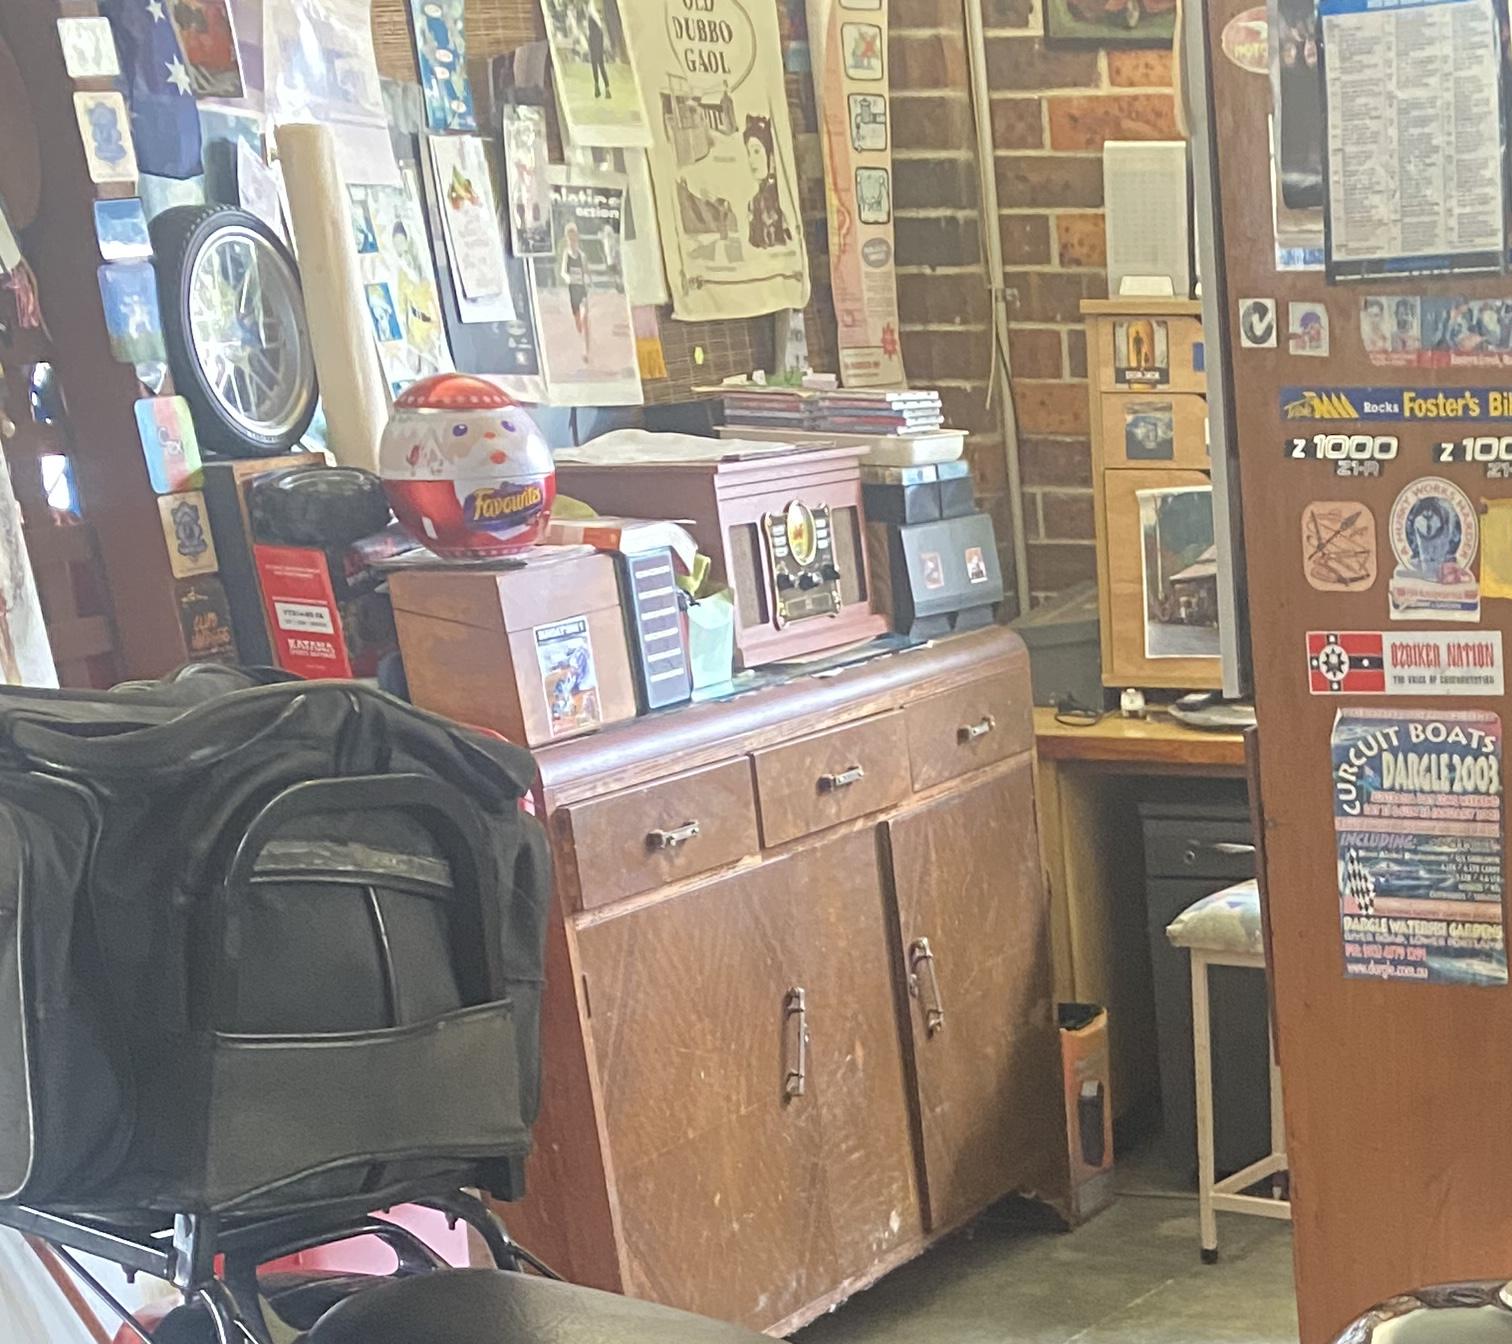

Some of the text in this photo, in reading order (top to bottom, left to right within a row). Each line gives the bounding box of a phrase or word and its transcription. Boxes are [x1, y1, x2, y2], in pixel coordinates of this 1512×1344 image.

[673, 16, 733, 44] DUBBO
[685, 49, 731, 75] GAOL
[1364, 402, 1399, 413] Rocks
[1403, 391, 1480, 417] Foster's
[1313, 434, 1398, 460] 1000
[1447, 643, 1494, 668] NATION
[1408, 722, 1496, 753] BOATS
[1382, 751, 1499, 793] DARGLE 2003
